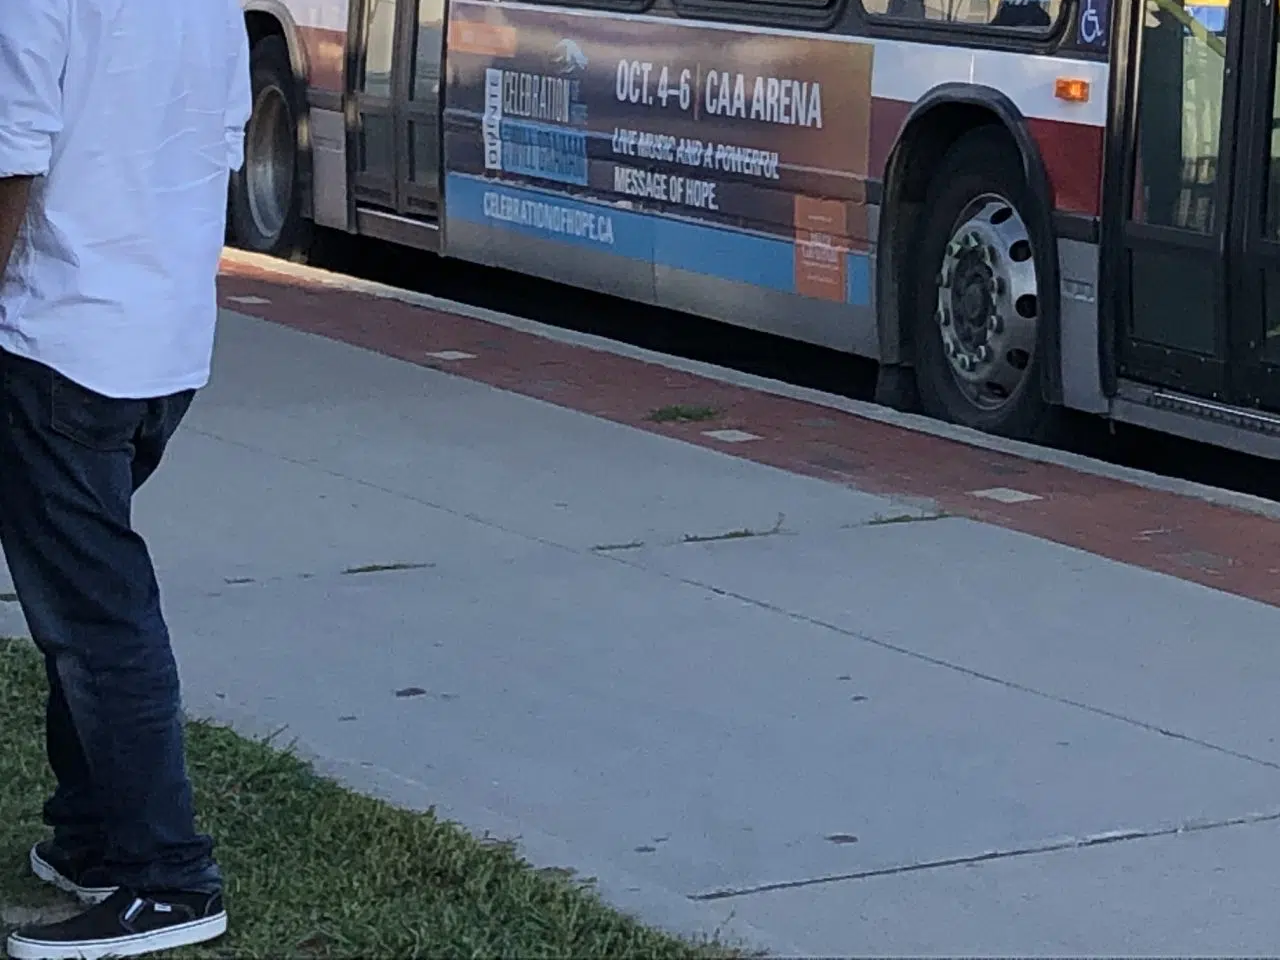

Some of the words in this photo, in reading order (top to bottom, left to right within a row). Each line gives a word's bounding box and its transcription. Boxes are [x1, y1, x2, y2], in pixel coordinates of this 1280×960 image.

[503, 69, 570, 124] CELEBRATION
[615, 58, 654, 106] OCT.
[705, 68, 746, 119] CAA
[750, 76, 823, 129] ARENA
[611, 126, 638, 157] LIVE
[637, 130, 676, 162] MUSIC
[676, 136, 703, 168] AND
[703, 142, 714, 169] A
[714, 142, 780, 181] POWERFUL
[614, 165, 668, 201] MESSAGE
[669, 175, 685, 204] OF
[685, 177, 720, 211] HOPE.
